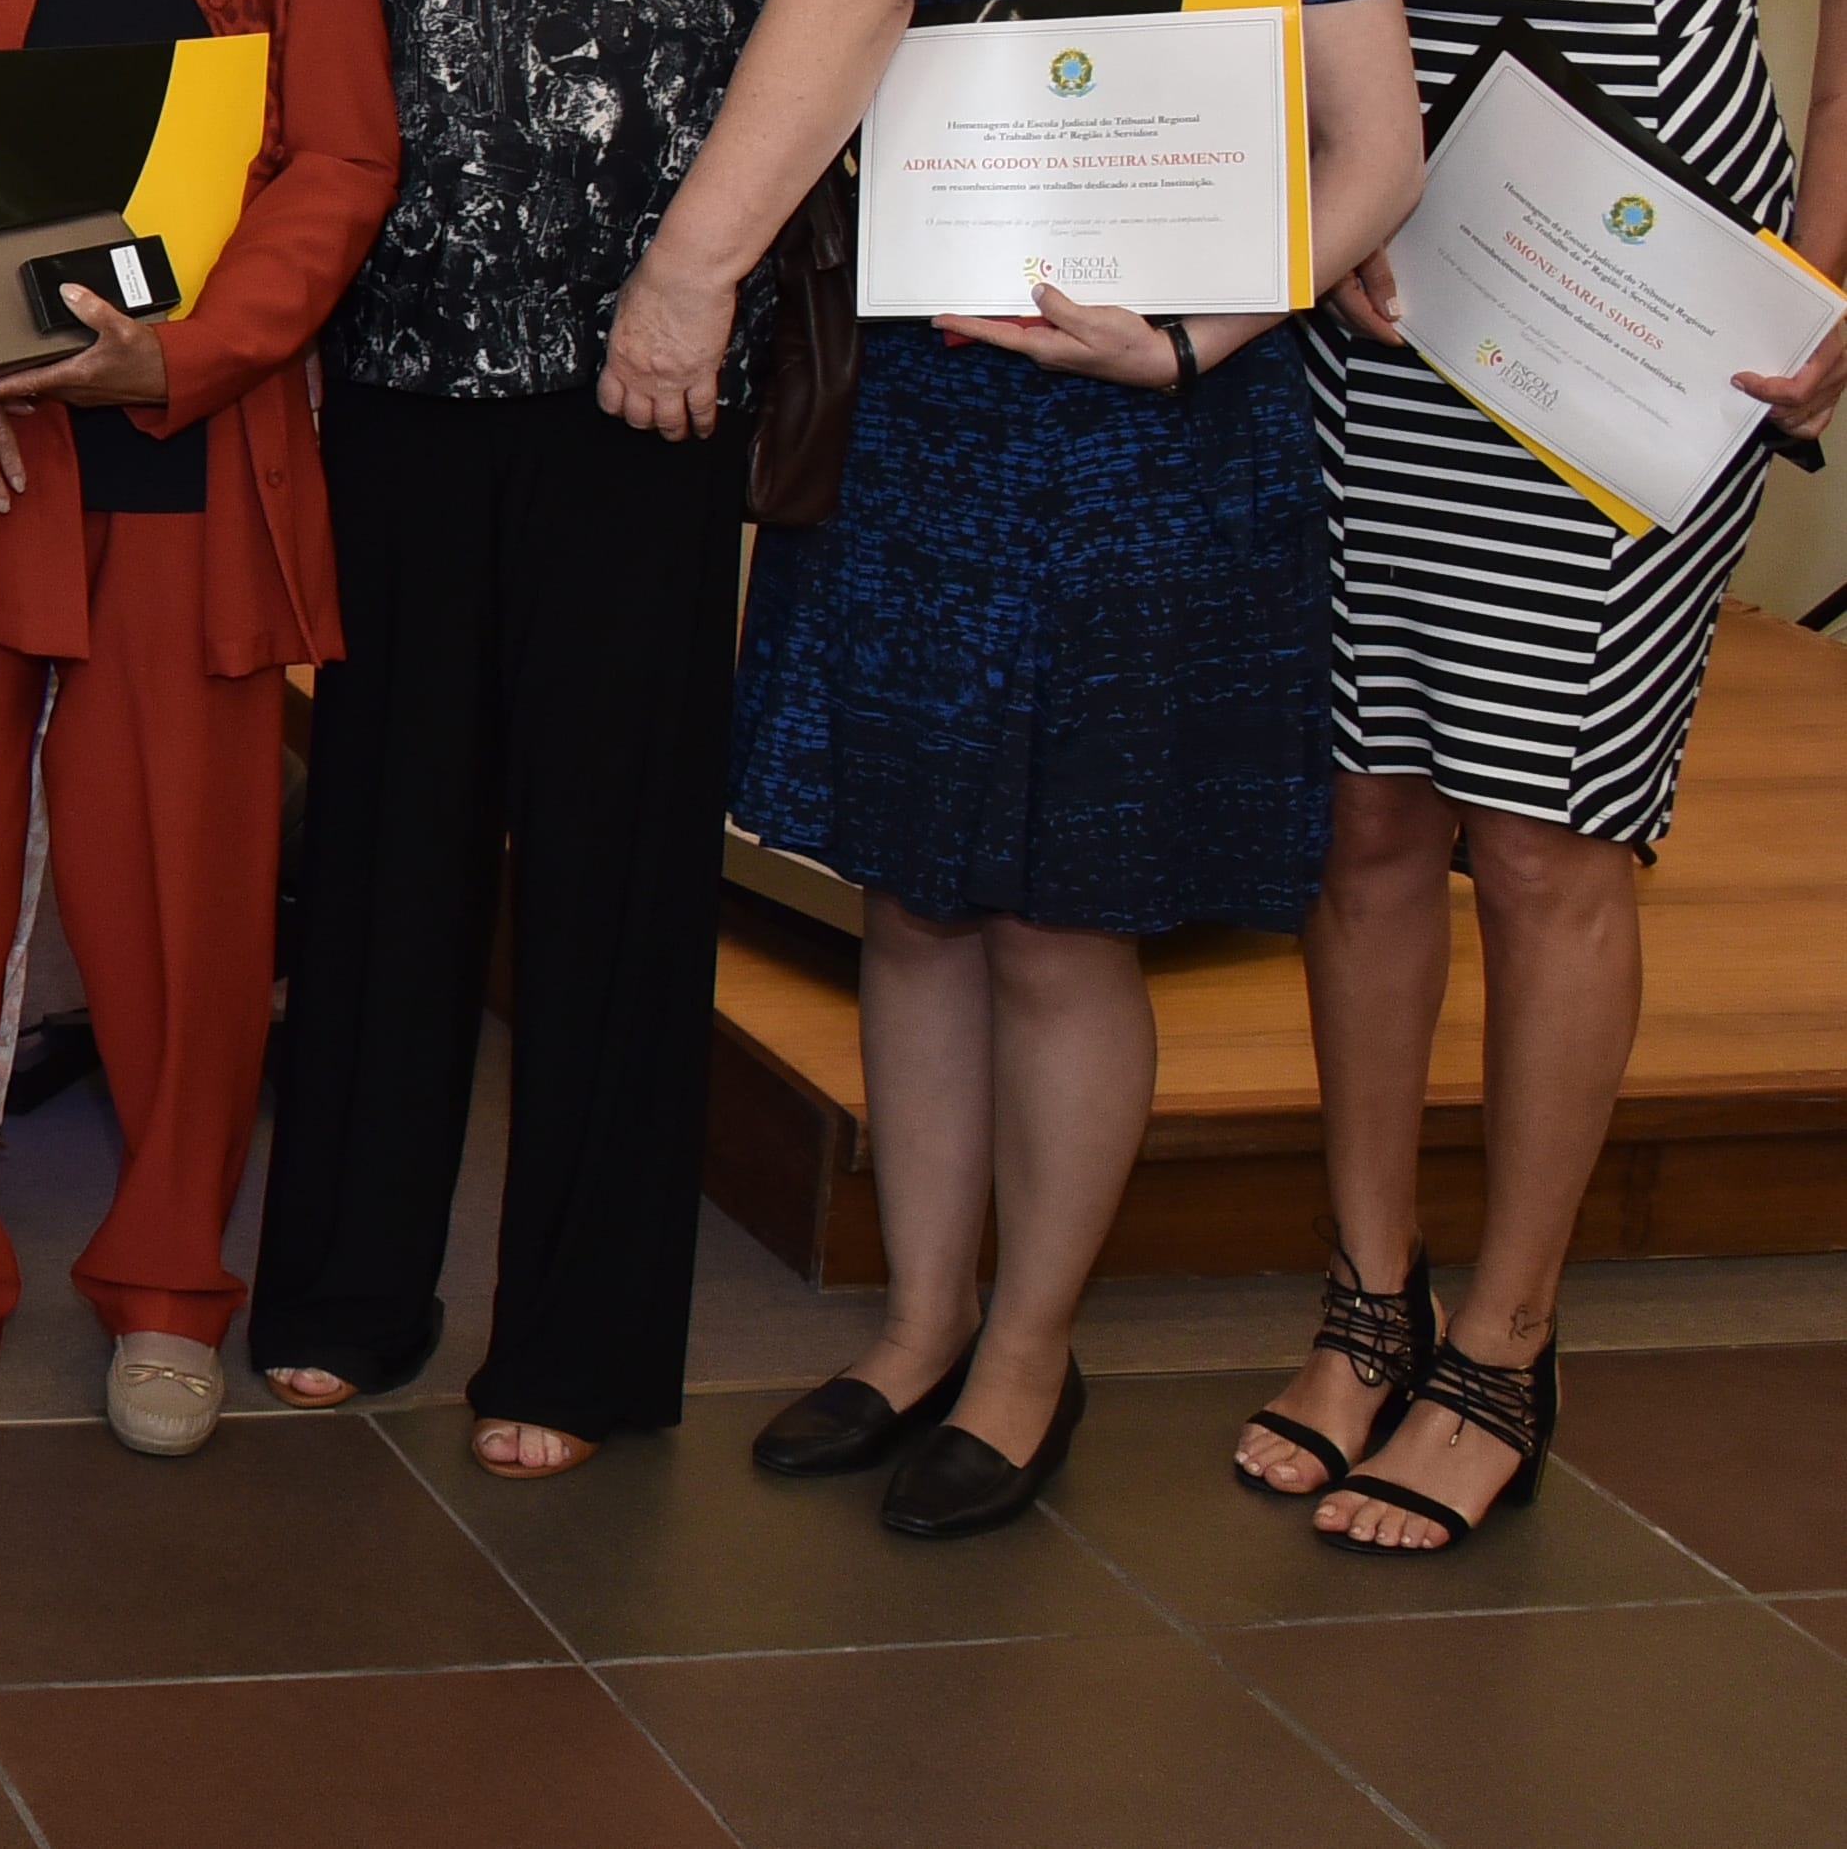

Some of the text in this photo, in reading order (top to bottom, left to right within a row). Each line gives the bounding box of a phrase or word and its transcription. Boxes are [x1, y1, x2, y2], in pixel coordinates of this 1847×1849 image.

[947, 115, 1200, 130] Homenagem da Escola Judicial do Tribunal Regional
[984, 133, 995, 141] do
[999, 132, 1042, 141] Trabalho
[1044, 132, 1056, 140] da
[1070, 130, 1103, 141] Região
[1113, 129, 1158, 139] Servidora
[903, 151, 1245, 171] ADRIANA GODOY DA SILVEIRA SARMENTO
[949, 183, 1026, 192] reconhecimento
[1043, 181, 1082, 191] trabalho
[1084, 180, 1129, 190] dedicado
[1161, 178, 1214, 190] Instituição.
[1062, 257, 1119, 268] ESCOLA
[1056, 268, 1122, 280] JUDICIAL
[1502, 229, 1558, 278] SIMONE
[1557, 272, 1607, 312] MARIA
